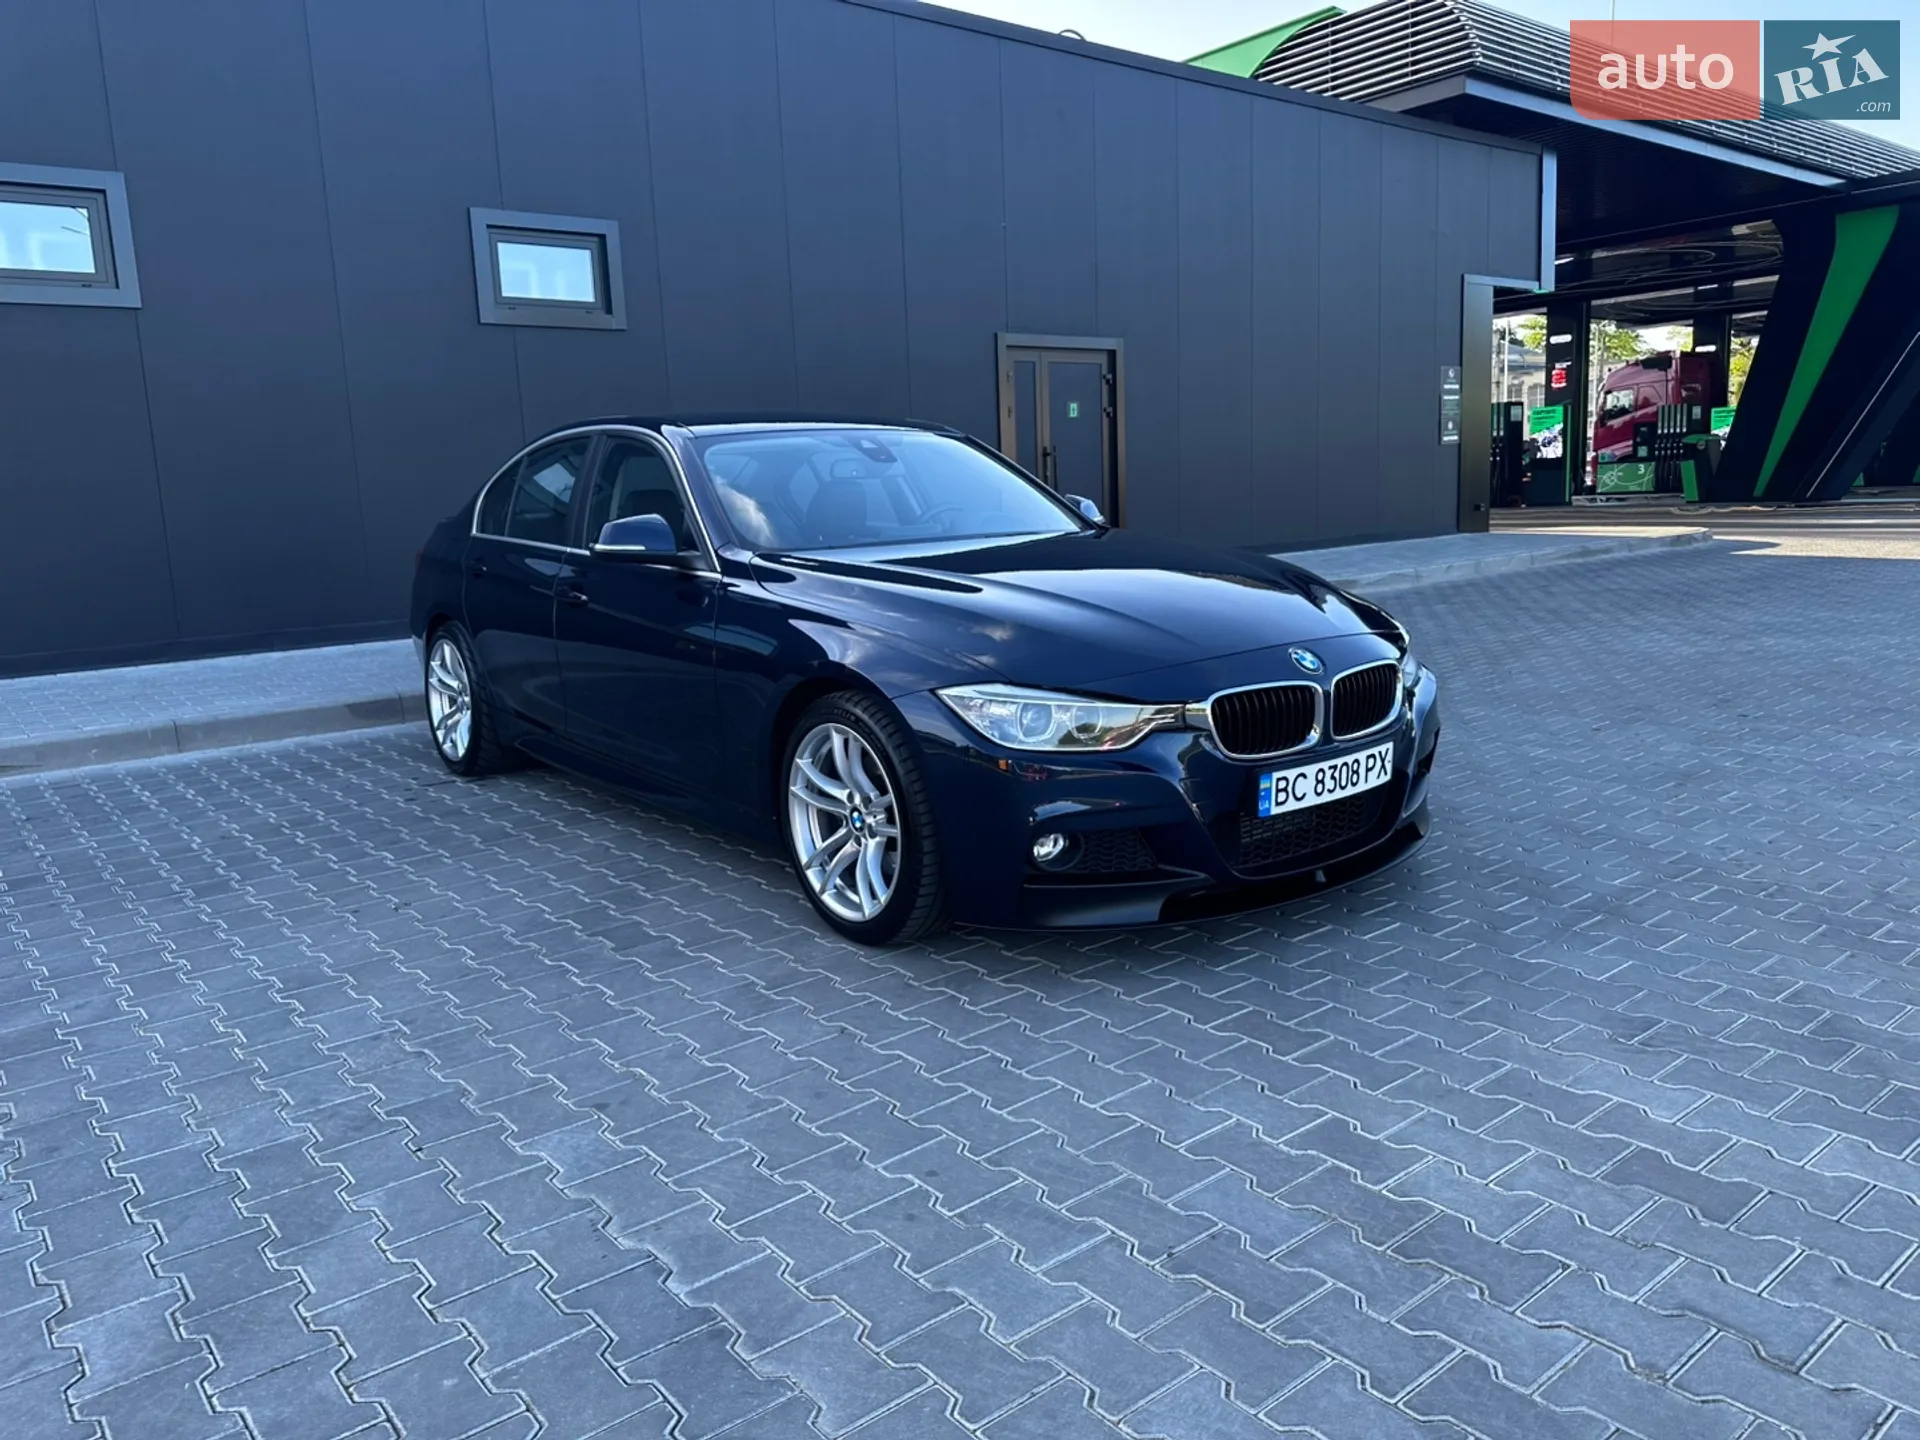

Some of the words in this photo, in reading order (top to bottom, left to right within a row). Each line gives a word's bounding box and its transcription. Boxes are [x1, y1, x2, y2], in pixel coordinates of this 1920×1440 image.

[1275, 772, 1308, 807] BC
[1314, 758, 1361, 797] 8308
[1364, 747, 1390, 784] PX
